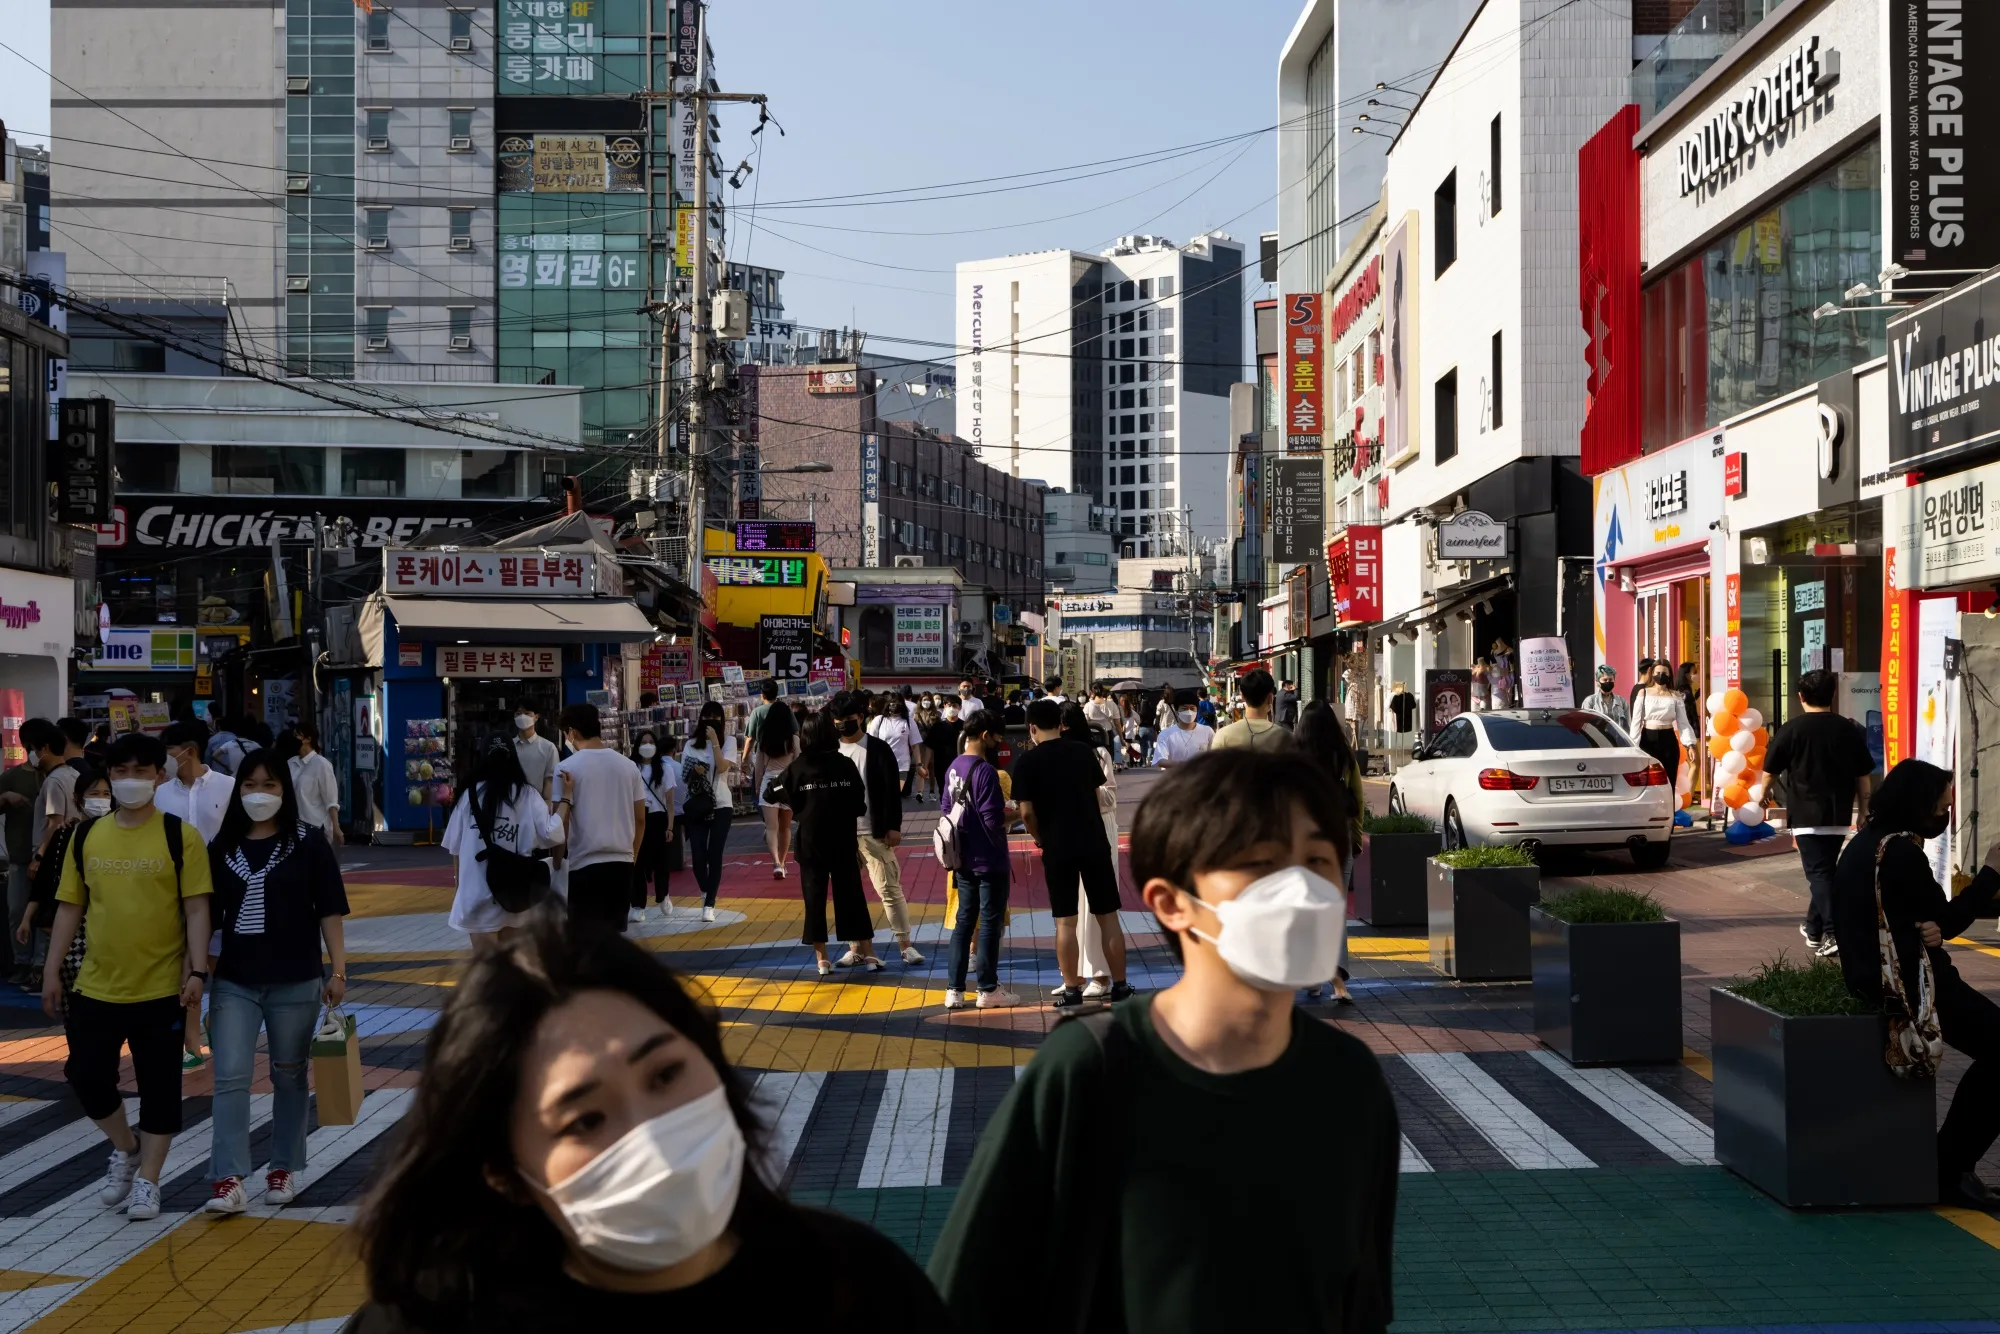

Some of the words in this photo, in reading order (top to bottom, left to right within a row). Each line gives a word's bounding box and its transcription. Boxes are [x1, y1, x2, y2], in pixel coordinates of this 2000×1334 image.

[571, 2, 594, 17] 8F
[505, 22, 594, 49] 룸블리
[1908, 4, 1918, 57] AMERICAN
[680, 26, 697, 73] 야구장
[505, 56, 594, 82] 룸카페
[1908, 61, 1918, 102] CASUAL
[1677, 102, 1741, 197] HOLLYS
[1742, 36, 1819, 145] COFFEE
[1909, 105, 1919, 137] WORK
[541, 156, 599, 170] 방탈출카페
[1910, 140, 1919, 170] WEAR
[1910, 181, 1920, 201] OLD
[1929, 148, 1965, 248] PLUS
[1910, 205, 1920, 239] SHOES
[502, 235, 556, 249] 홍대앞
[500, 254, 602, 287] 영화관
[607, 255, 637, 287] 6F
[972, 284, 983, 356] Mercure
[1293, 338, 1316, 354] 룸
[1293, 361, 1316, 392] 호프
[1893, 332, 1960, 414] VINTAGE
[1293, 399, 1316, 432] 소주
[865, 447, 877, 499] 호미화방
[1275, 467, 1283, 534] VINTAGE
[136, 505, 316, 548] CHICKEN
[1286, 487, 1294, 554] BROTHER
[1309, 548, 1319, 556] B1
[1446, 535, 1502, 549] aimerfeel
[395, 557, 484, 586] 폰케이스
[499, 557, 584, 588] 필름부착
[1355, 539, 1377, 608] 빈티지
[763, 618, 810, 628] 아메리카노
[897, 608, 921, 617] 브랜드
[924, 608, 940, 617] 광고
[897, 621, 921, 629] 신제품
[897, 633, 913, 642] 팝업
[915, 633, 940, 642] 스토어
[444, 652, 515, 673] 필름부착
[520, 652, 554, 673] 전문
[762, 652, 809, 678] 1.5
[813, 657, 833, 670] 1.5
[1851, 687, 1872, 695] Galaxy
[799, 781, 817, 791] acmé
[1556, 780, 1575, 789] 51누
[1580, 779, 1606, 788] 7400
[86, 857, 165, 872] Discovery
